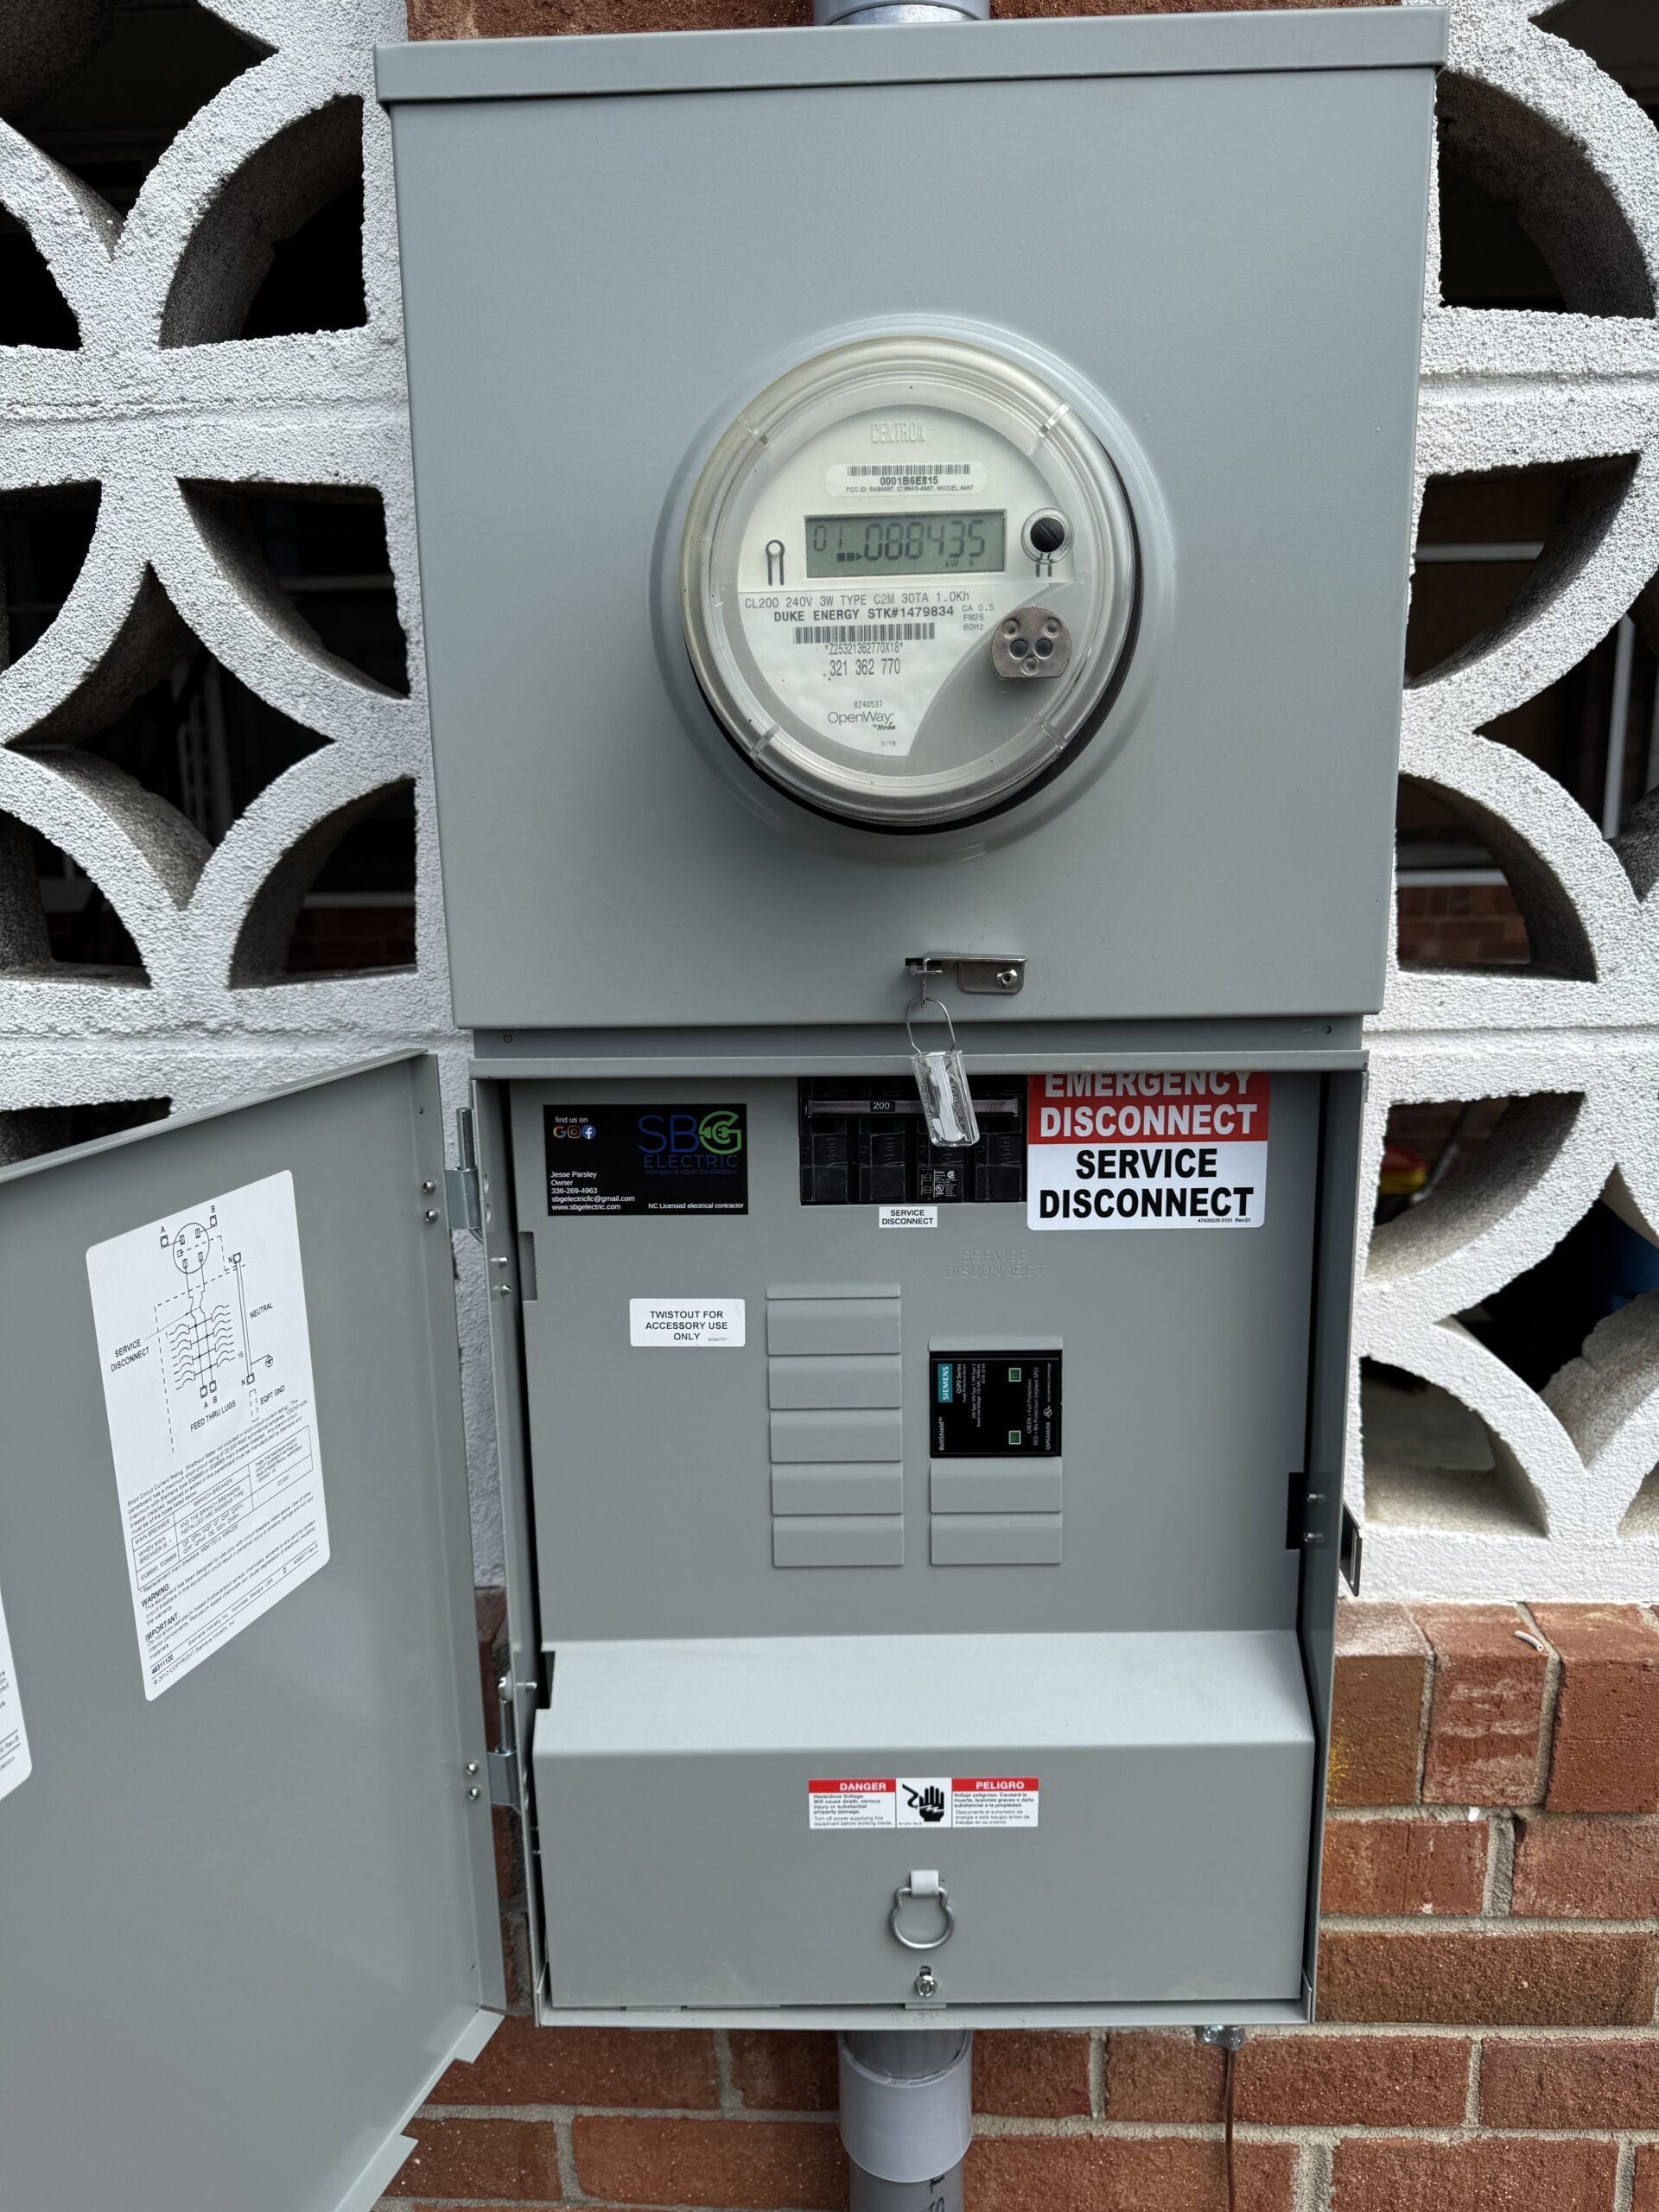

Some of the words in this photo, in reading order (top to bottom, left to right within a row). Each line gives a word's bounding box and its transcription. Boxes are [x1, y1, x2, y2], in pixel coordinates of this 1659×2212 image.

[871, 421, 925, 442] CENTRON
[880, 476, 938, 486] 0001B6E815
[864, 519, 985, 560] 088435
[745, 597, 779, 608] CL200
[786, 596, 812, 607] 240V
[820, 595, 833, 606] 3W
[840, 594, 867, 606] TYPE
[874, 594, 894, 605] C2M
[901, 592, 929, 603] 30TA
[774, 611, 805, 622] DUKE
[814, 609, 859, 621] ENERGY
[868, 606, 954, 619] STK#1479834
[830, 659, 847, 676] 321
[855, 658, 874, 676] 362
[881, 658, 900, 674] 770
[854, 700, 883, 708] 8240537
[828, 711, 893, 725] OpenWay
[1046, 1071, 1255, 1097] EMERGENCY
[1040, 1104, 1258, 1137] DISCONNECT
[638, 1110, 742, 1154] SBG
[644, 1154, 738, 1168] ELECTRIC
[1076, 1148, 1217, 1179] SERVICE
[210, 1205, 215, 1214] B
[1039, 1187, 1254, 1218] DISCONNECT
[160, 1224, 166, 1234] A
[962, 1248, 1029, 1262] SERVICE
[946, 1263, 1045, 1279] DISCONNECT
[249, 1301, 273, 1319] NEUTRAL
[114, 1338, 141, 1357] SERVICE
[110, 1346, 149, 1372] DISCONNECT
[241, 1378, 245, 1387] N
[203, 1400, 208, 1410] A
[212, 1395, 217, 1404] B
[259, 1391, 273, 1405] EQPT
[274, 1384, 285, 1396] GND
[189, 1417, 205, 1432] FEED
[205, 1409, 219, 1423] THRU
[219, 1400, 236, 1414] LUGS
[141, 1581, 171, 1608] WARNING:
[144, 1610, 180, 1643] IMPORTANT:
[840, 1783, 886, 1791] DANGER
